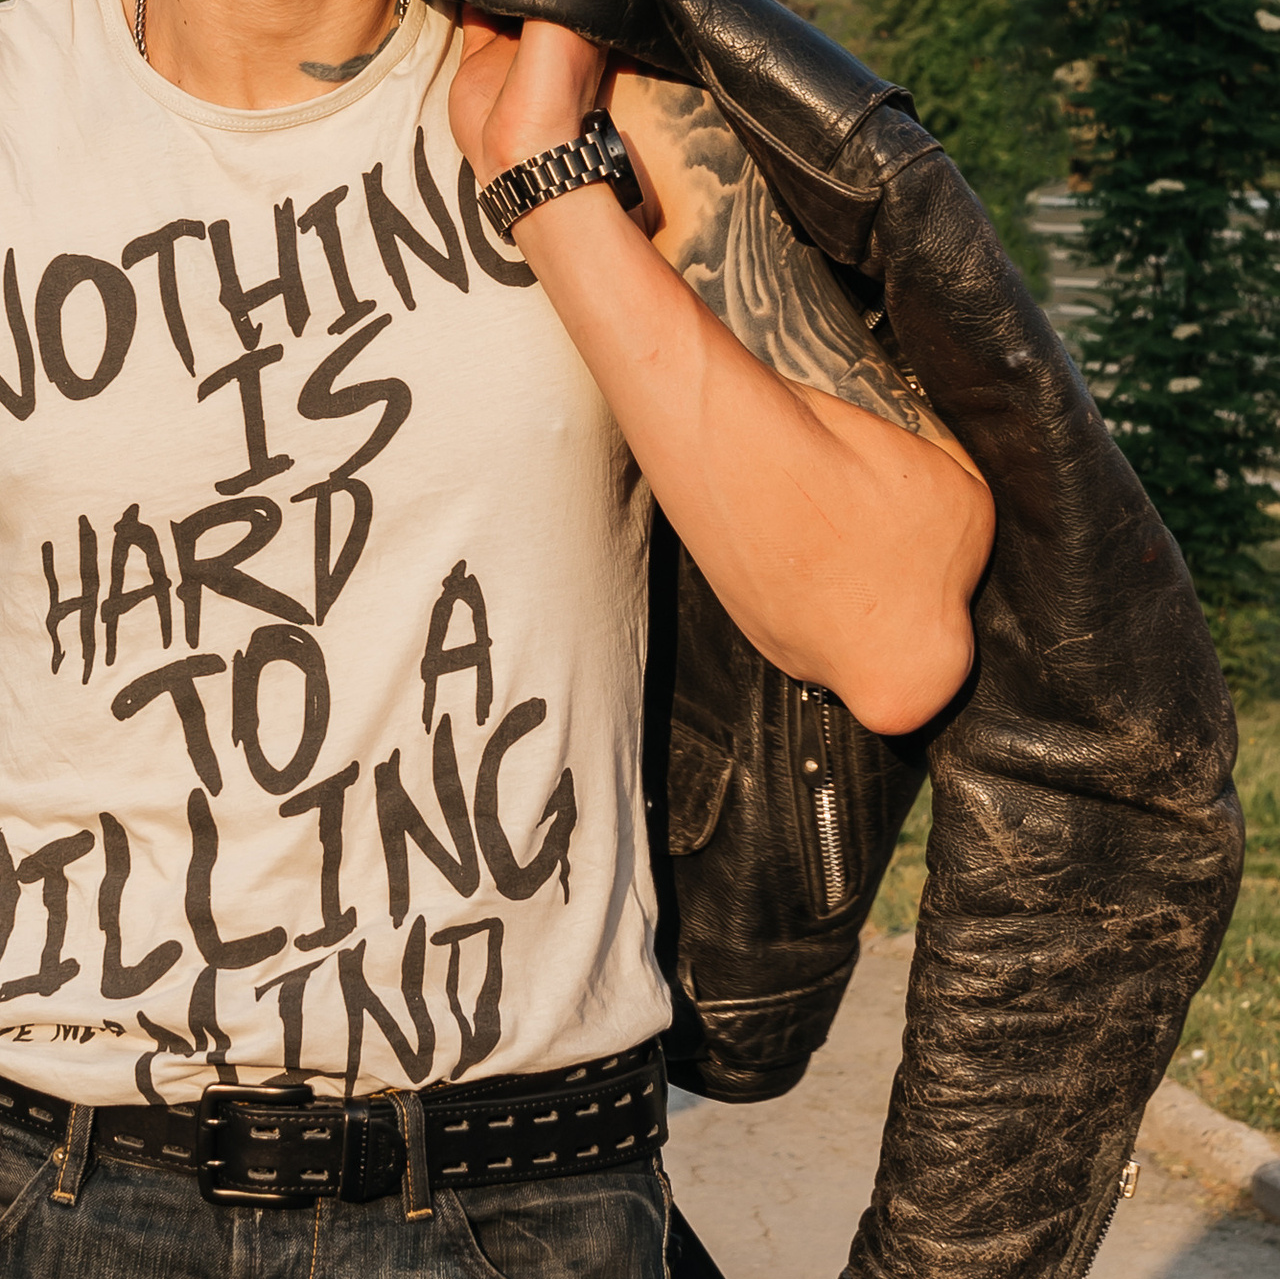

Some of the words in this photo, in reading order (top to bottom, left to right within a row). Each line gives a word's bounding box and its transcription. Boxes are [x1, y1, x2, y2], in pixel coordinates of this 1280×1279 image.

[198, 314, 413, 495] IS
[42, 477, 373, 685] HARD
[111, 624, 330, 797] TO
[421, 560, 493, 735] A
